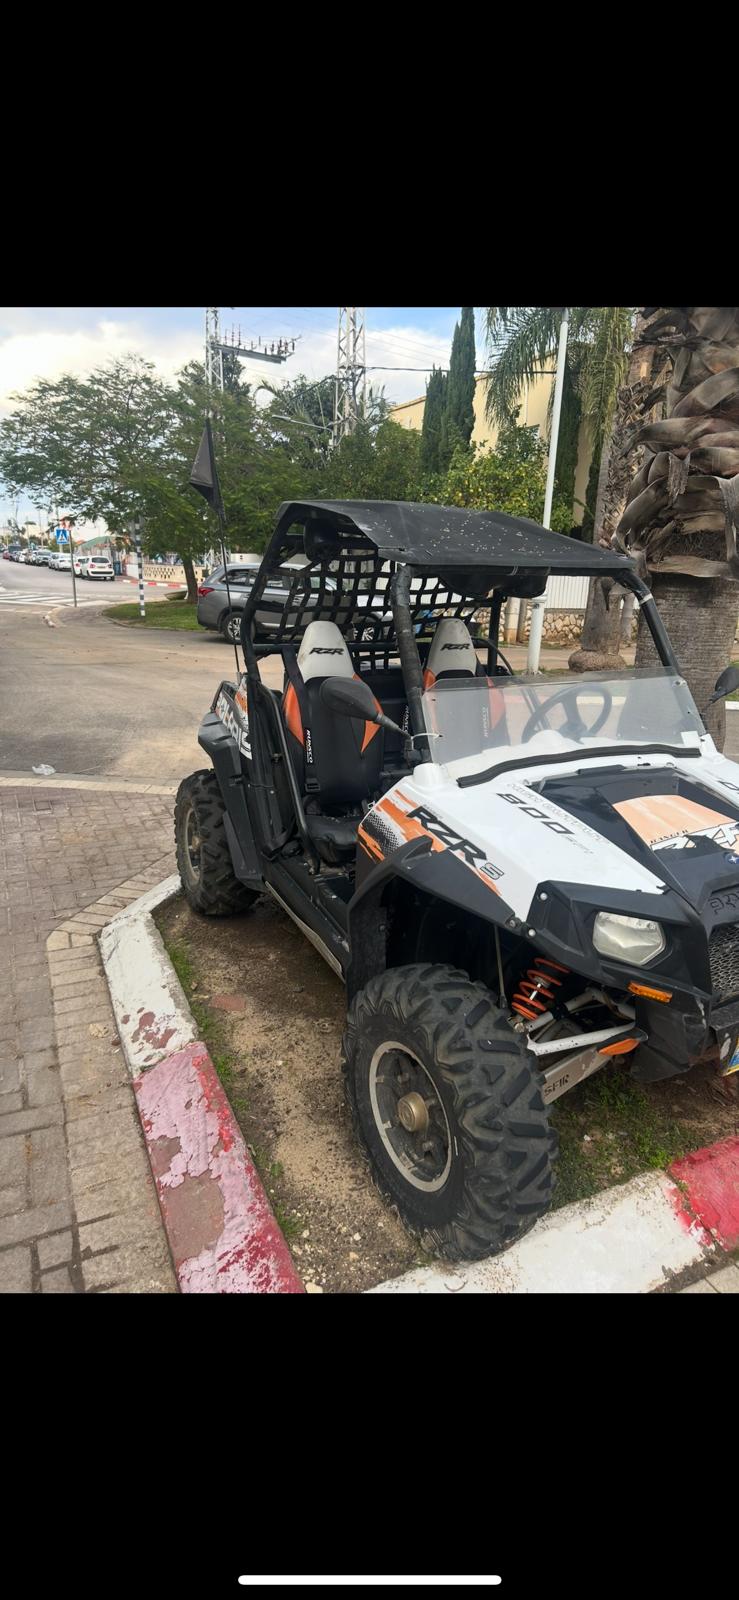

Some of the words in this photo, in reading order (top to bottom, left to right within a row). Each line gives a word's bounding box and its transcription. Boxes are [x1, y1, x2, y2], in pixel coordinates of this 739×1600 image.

[309, 647, 344, 655] RZR
[440, 643, 470, 651] RZR
[496, 793, 576, 835] 800
[406, 806, 487, 869] RZR
